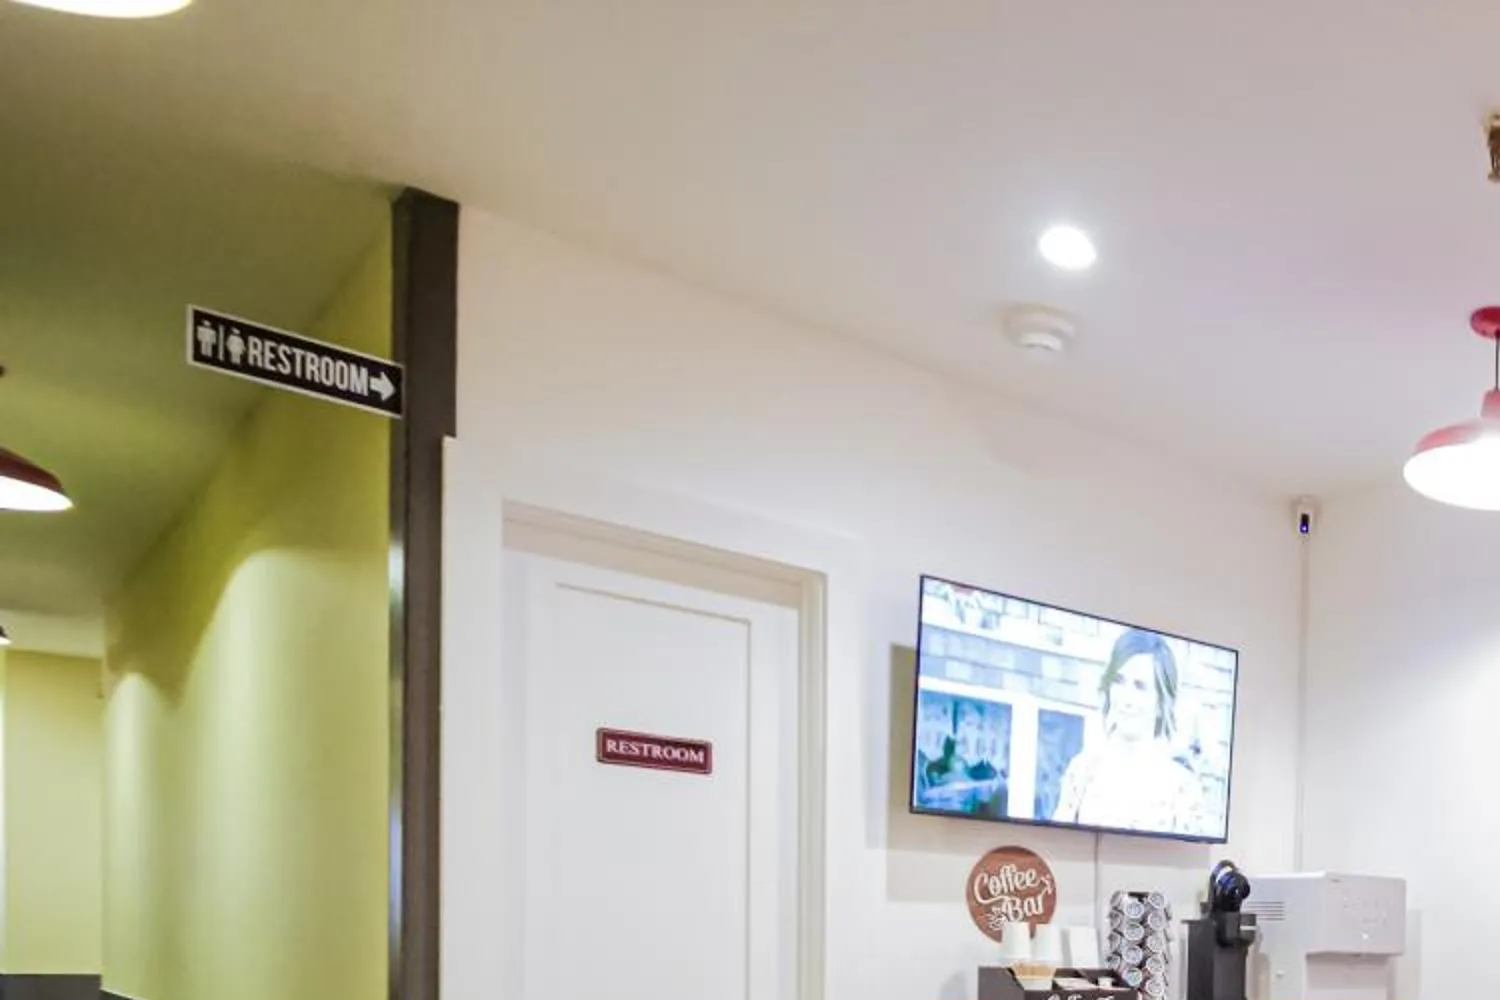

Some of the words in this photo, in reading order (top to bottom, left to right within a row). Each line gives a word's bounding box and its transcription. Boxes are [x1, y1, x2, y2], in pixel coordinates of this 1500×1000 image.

[247, 335, 369, 397] RESTROOM
[605, 738, 705, 764] RESTROOM
[974, 863, 1041, 905] Coffee
[1001, 884, 1049, 922] Bar
